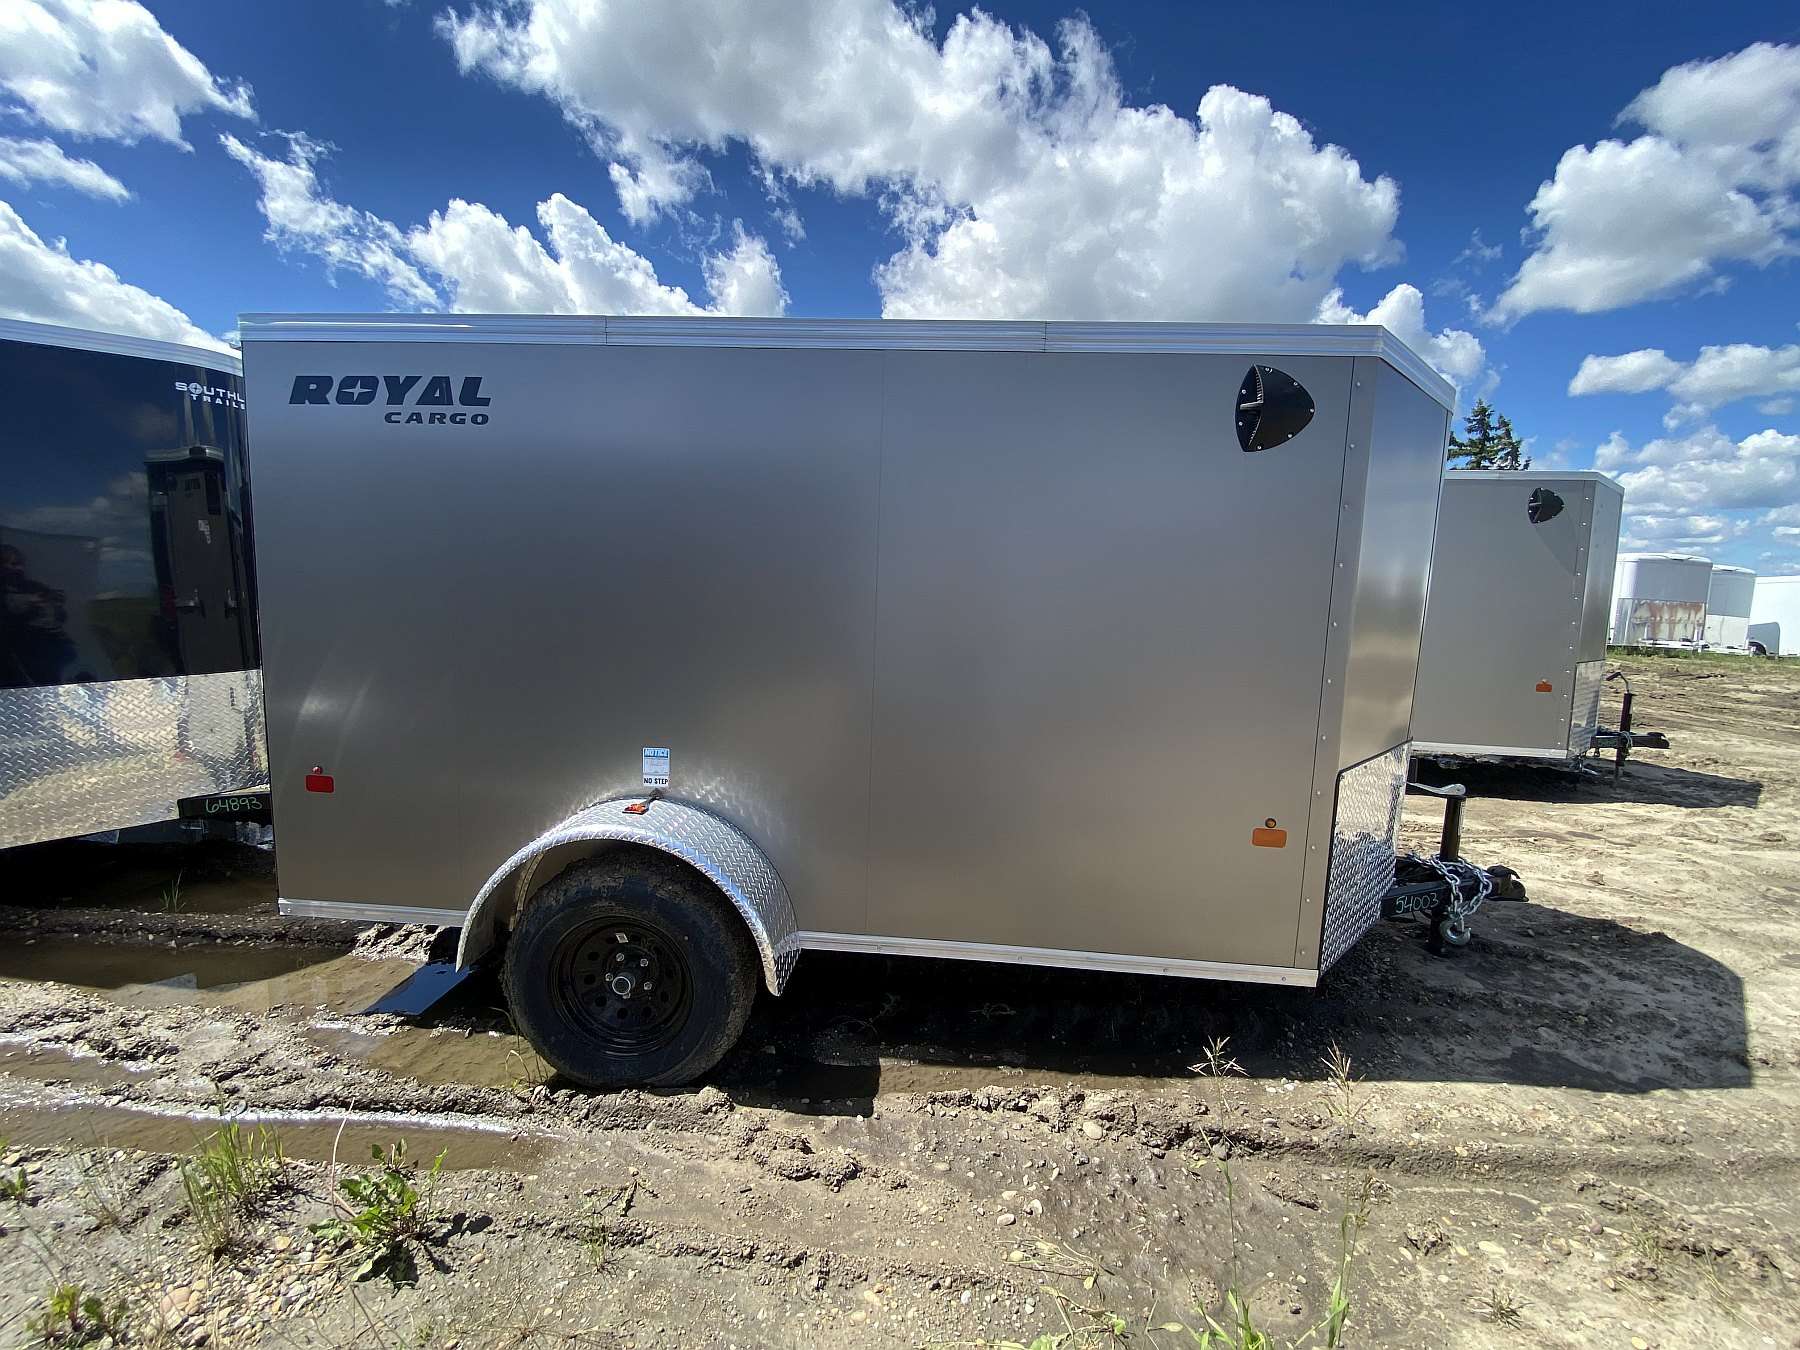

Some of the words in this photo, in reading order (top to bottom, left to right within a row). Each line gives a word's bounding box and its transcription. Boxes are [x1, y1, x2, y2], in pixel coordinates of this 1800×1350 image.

[288, 375, 491, 407] ROYAL
[384, 411, 489, 425] CARGO
[654, 777, 669, 785] STEP
[205, 796, 263, 813] 64893
[1395, 892, 1439, 914] 54003
